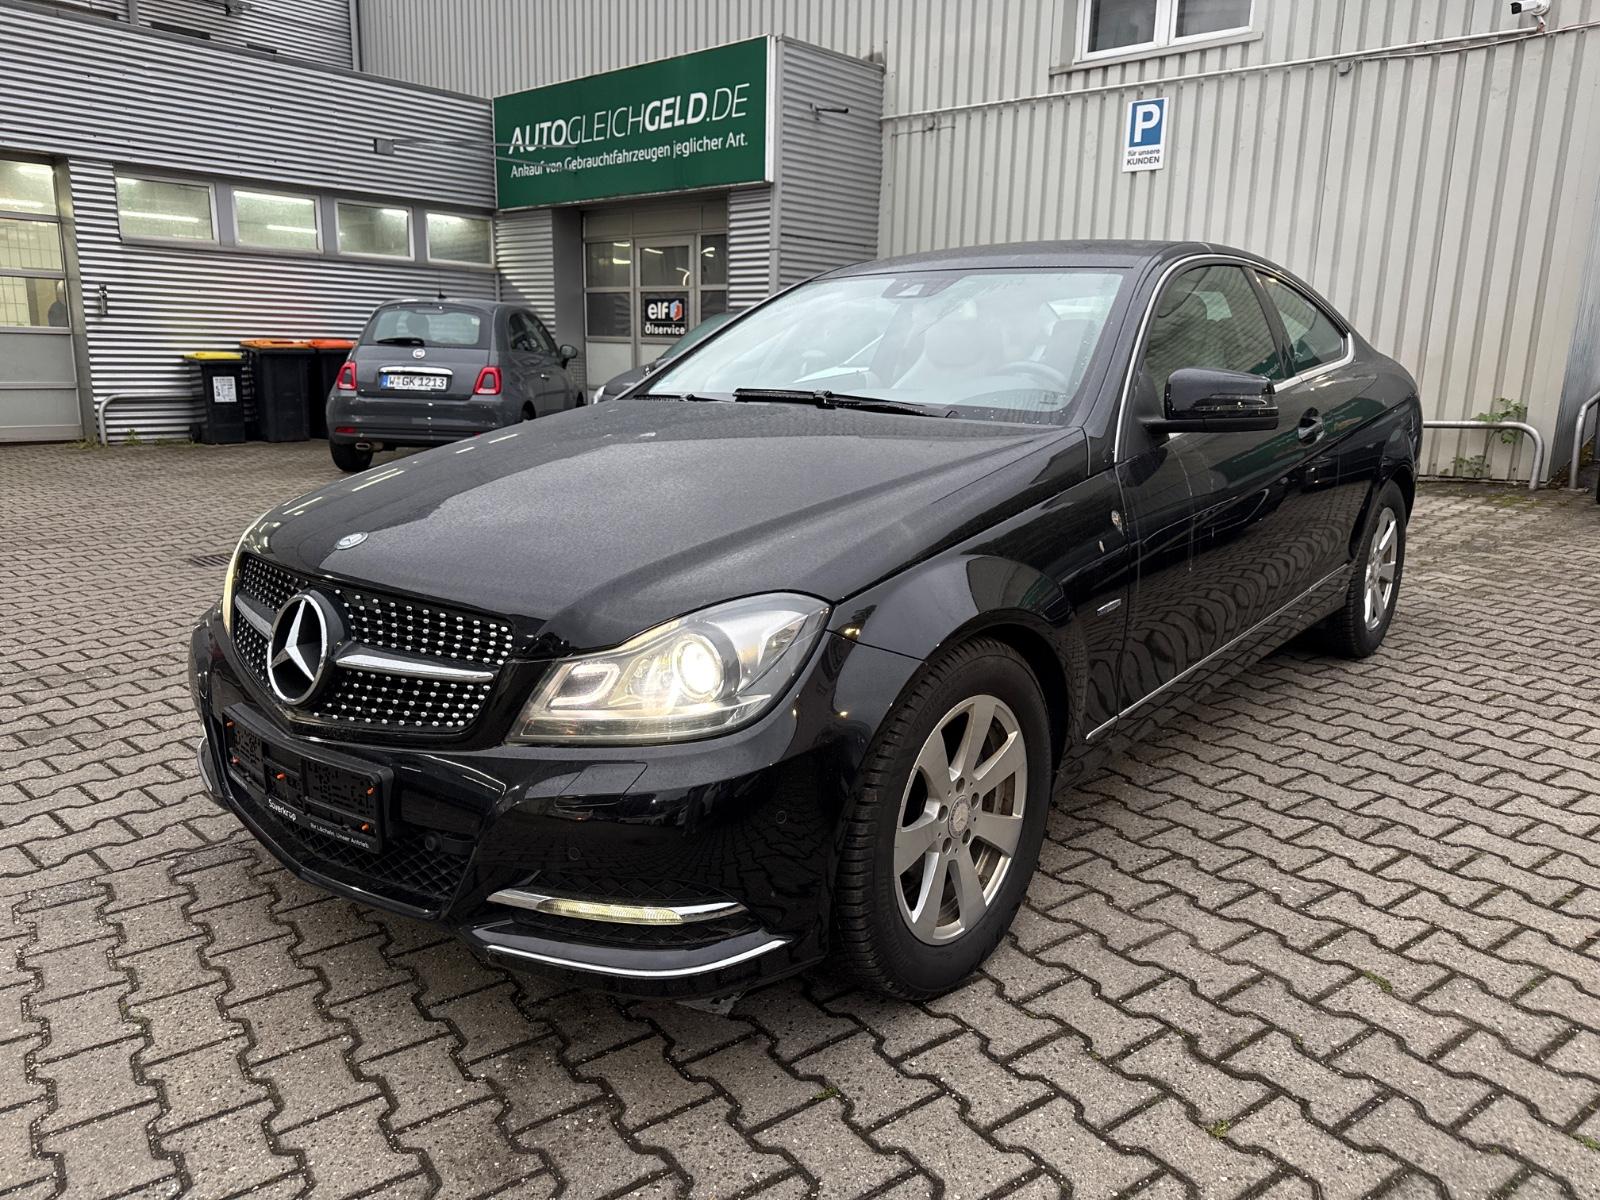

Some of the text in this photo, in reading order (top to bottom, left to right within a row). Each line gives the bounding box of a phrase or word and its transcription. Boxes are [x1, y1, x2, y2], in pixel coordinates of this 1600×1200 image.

[508, 83, 750, 155] AUTOGLEICHGELD.DE
[1133, 103, 1161, 143] P
[510, 131, 748, 178] Ankauf von Gebrauchtfahrzeugen jeglicher Art.
[1127, 156, 1160, 166] KUNDEN
[647, 301, 669, 319] elf
[645, 322, 685, 335] Ölservice
[418, 377, 446, 388] 1213
